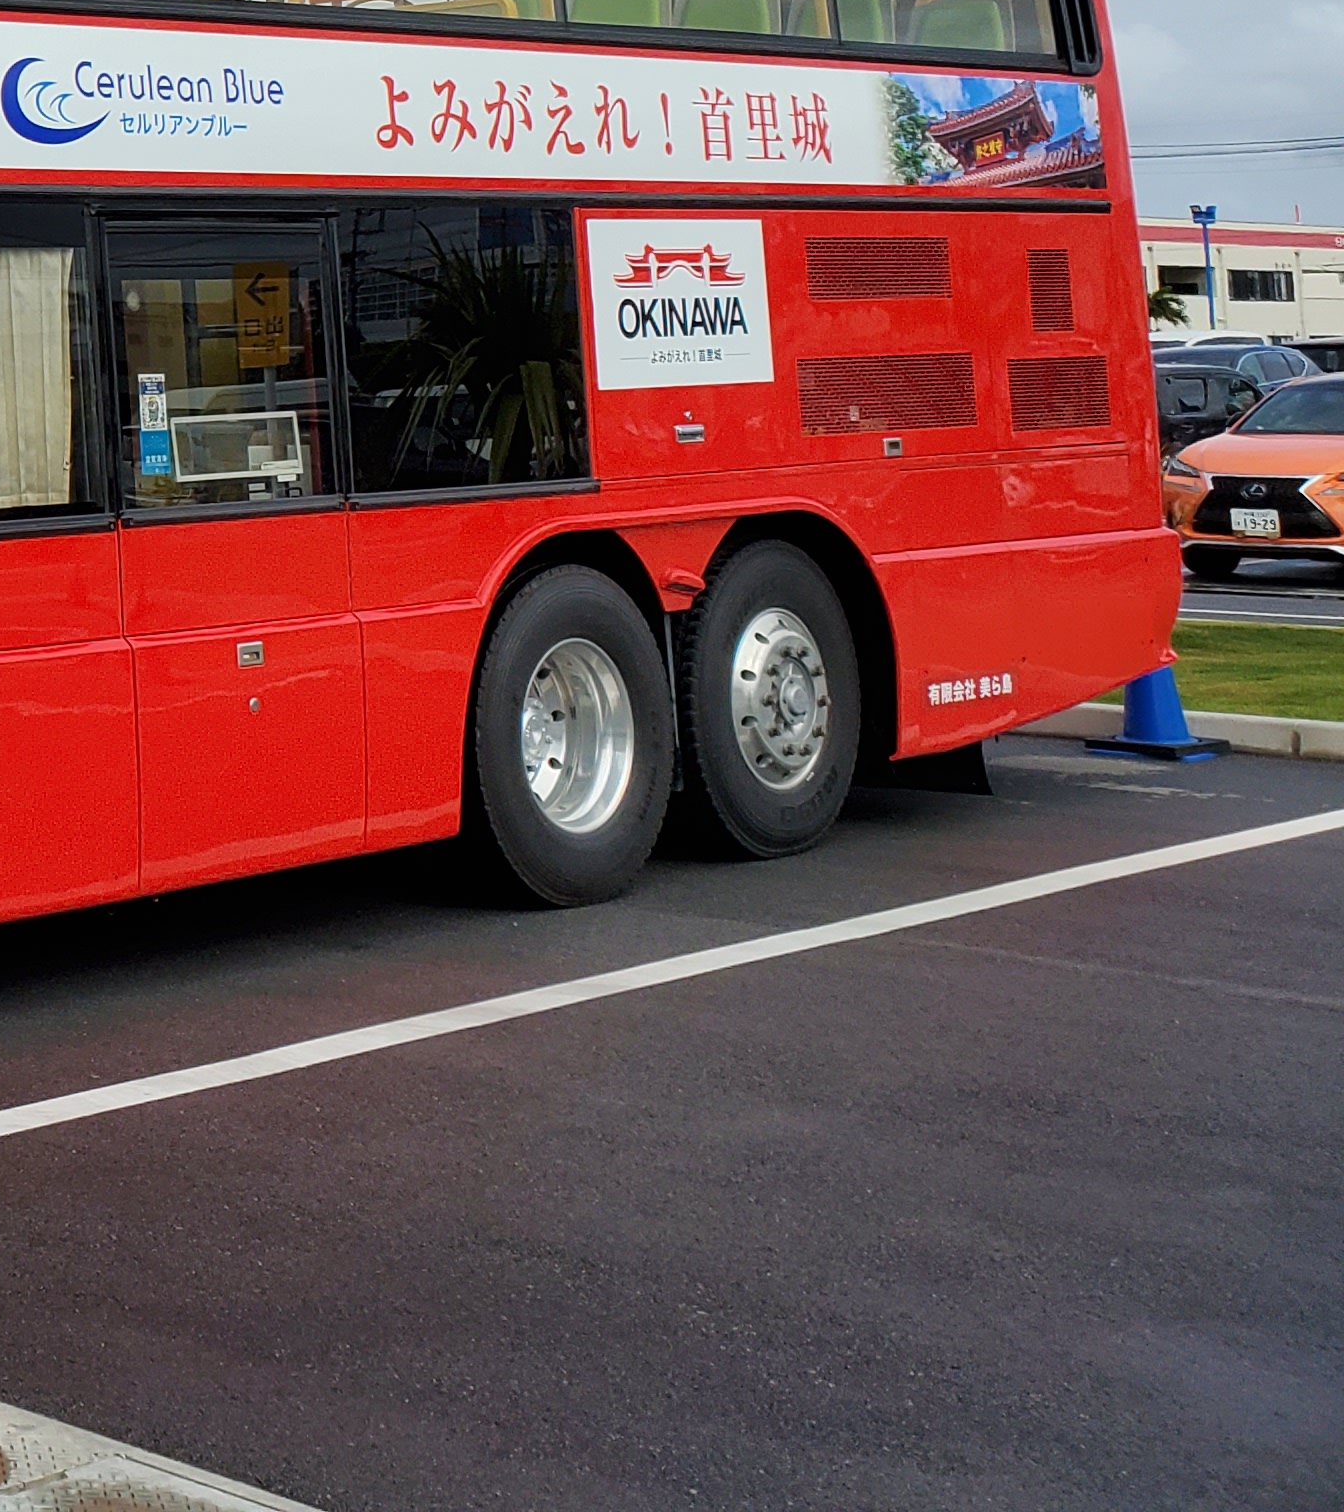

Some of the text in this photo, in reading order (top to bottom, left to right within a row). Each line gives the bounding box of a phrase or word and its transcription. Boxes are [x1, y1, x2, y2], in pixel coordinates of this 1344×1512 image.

[75, 60, 285, 105] Cerulean Blue
[119, 113, 249, 139] セルリアンブルー
[376, 75, 833, 164] よみがえれ！首里城
[618, 296, 749, 340] OKINAWA
[927, 678, 977, 706] 有限会社
